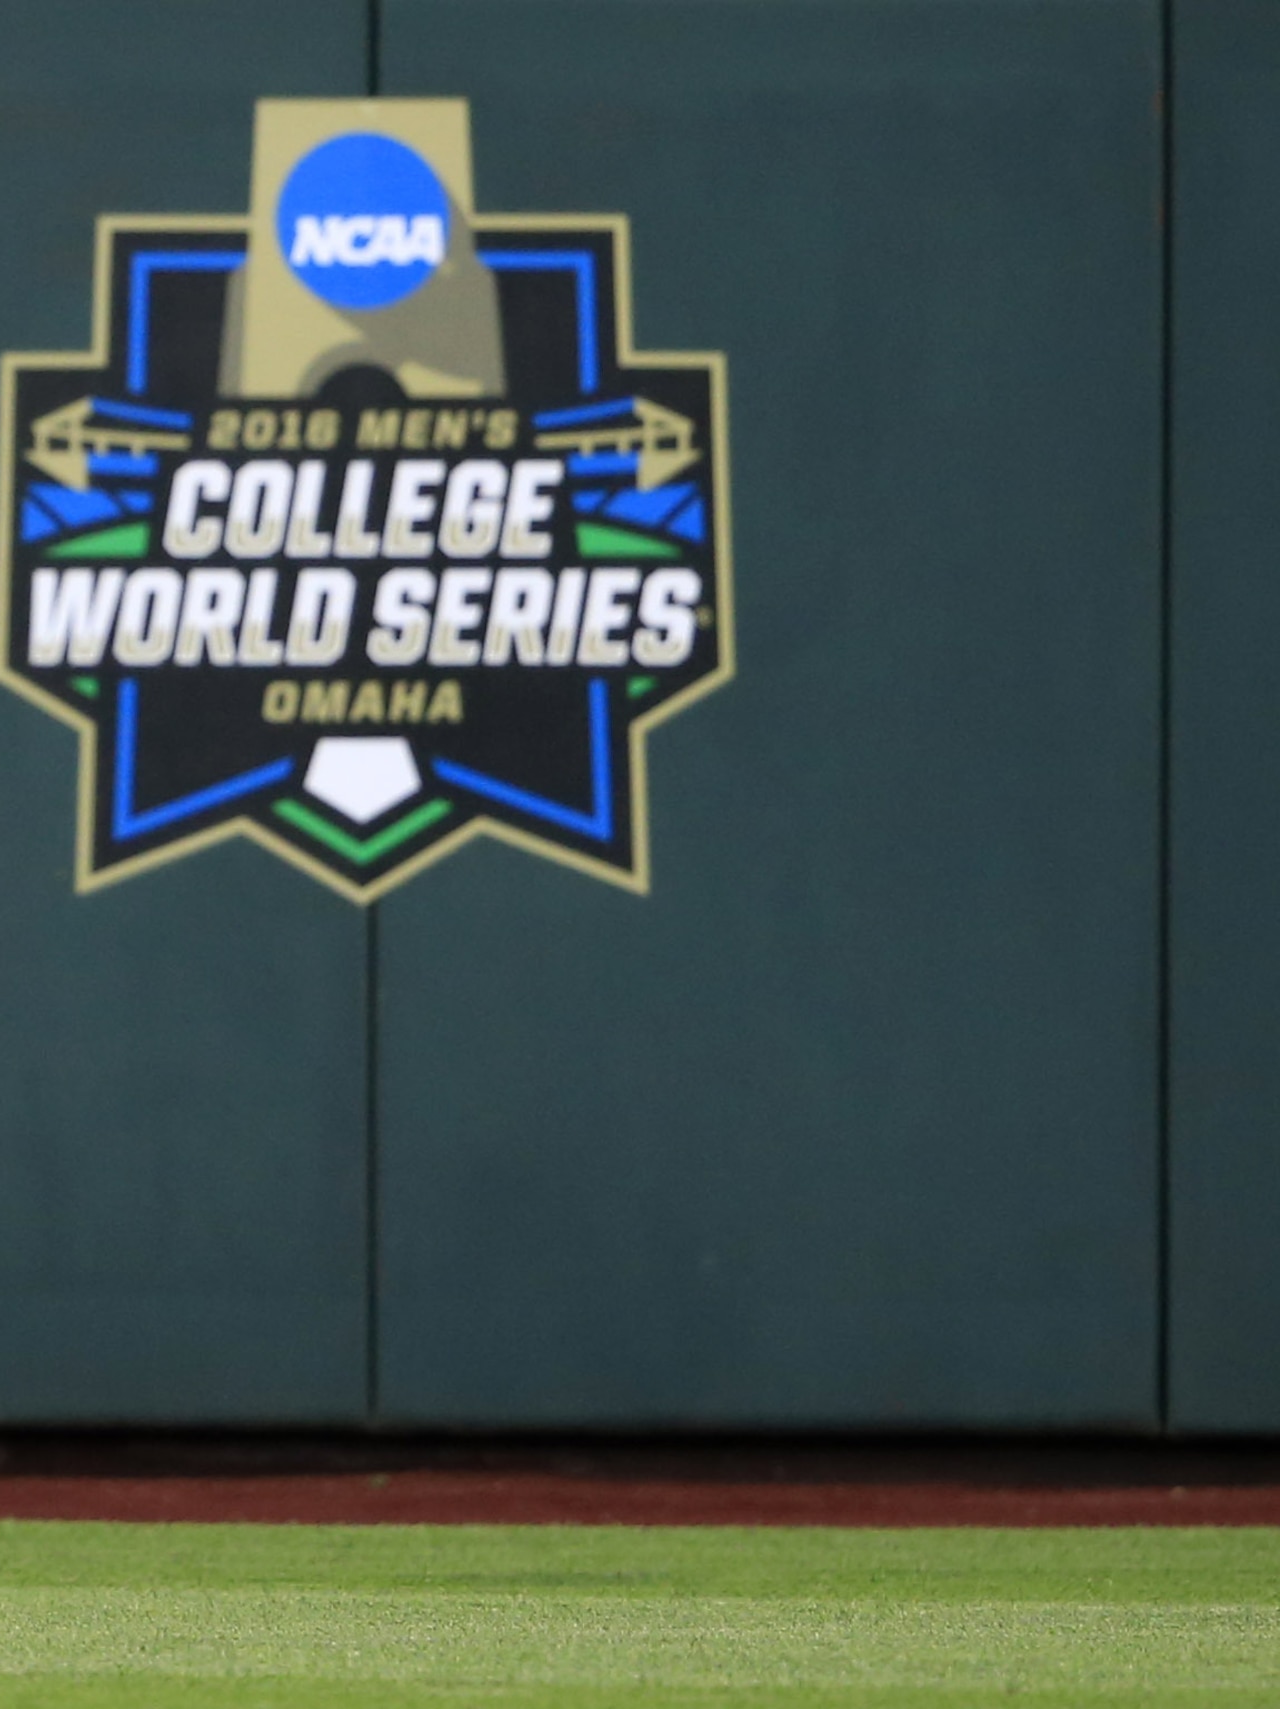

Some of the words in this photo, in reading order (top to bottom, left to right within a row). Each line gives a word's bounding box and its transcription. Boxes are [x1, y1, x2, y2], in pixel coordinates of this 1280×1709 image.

[290, 214, 446, 267] NCAA
[356, 410, 518, 450] MEN'S
[162, 459, 564, 560] COLLEGE
[27, 568, 356, 668] WORLD
[365, 568, 703, 668] SERIES
[262, 681, 464, 723] OMAHA
